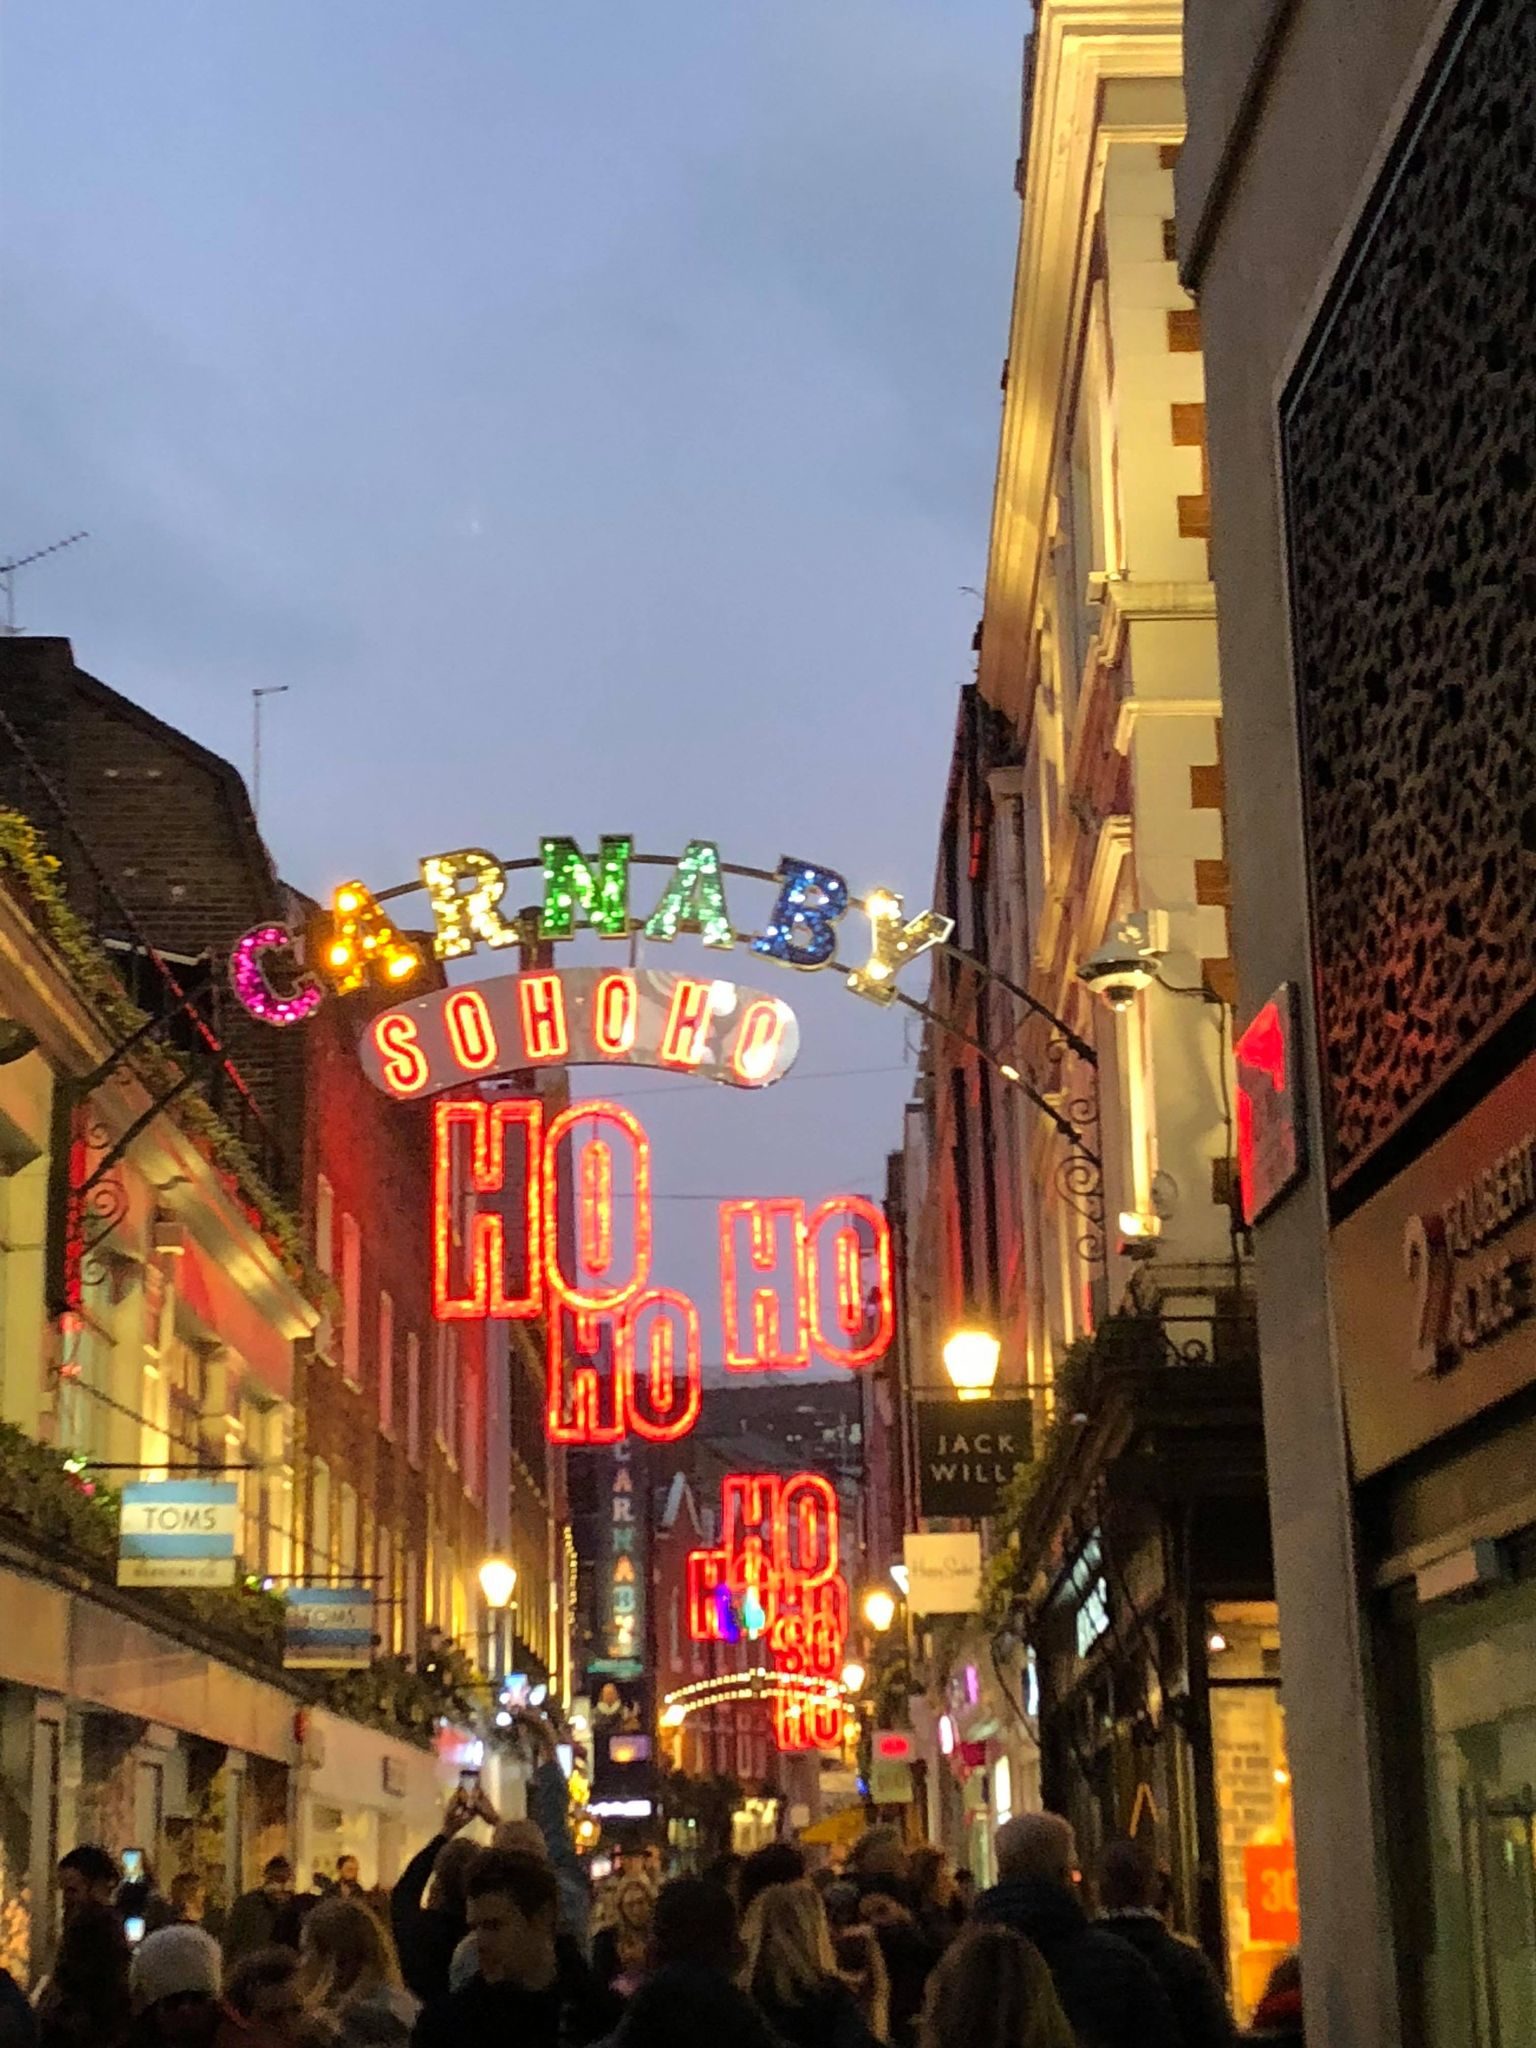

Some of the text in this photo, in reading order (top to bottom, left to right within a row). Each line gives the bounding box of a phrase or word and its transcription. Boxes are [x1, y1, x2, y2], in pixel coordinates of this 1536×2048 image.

[229, 834, 955, 1027] CARNABY
[433, 1099, 651, 1320] HO
[719, 1195, 895, 1372] HO
[545, 1287, 701, 1444] HO
[930, 1463, 1010, 1484] WILL
[936, 1434, 1014, 1456] JACK
[141, 1507, 217, 1530] TOMS
[720, 1472, 840, 1588] HO
[303, 1607, 357, 1627] TOMS
